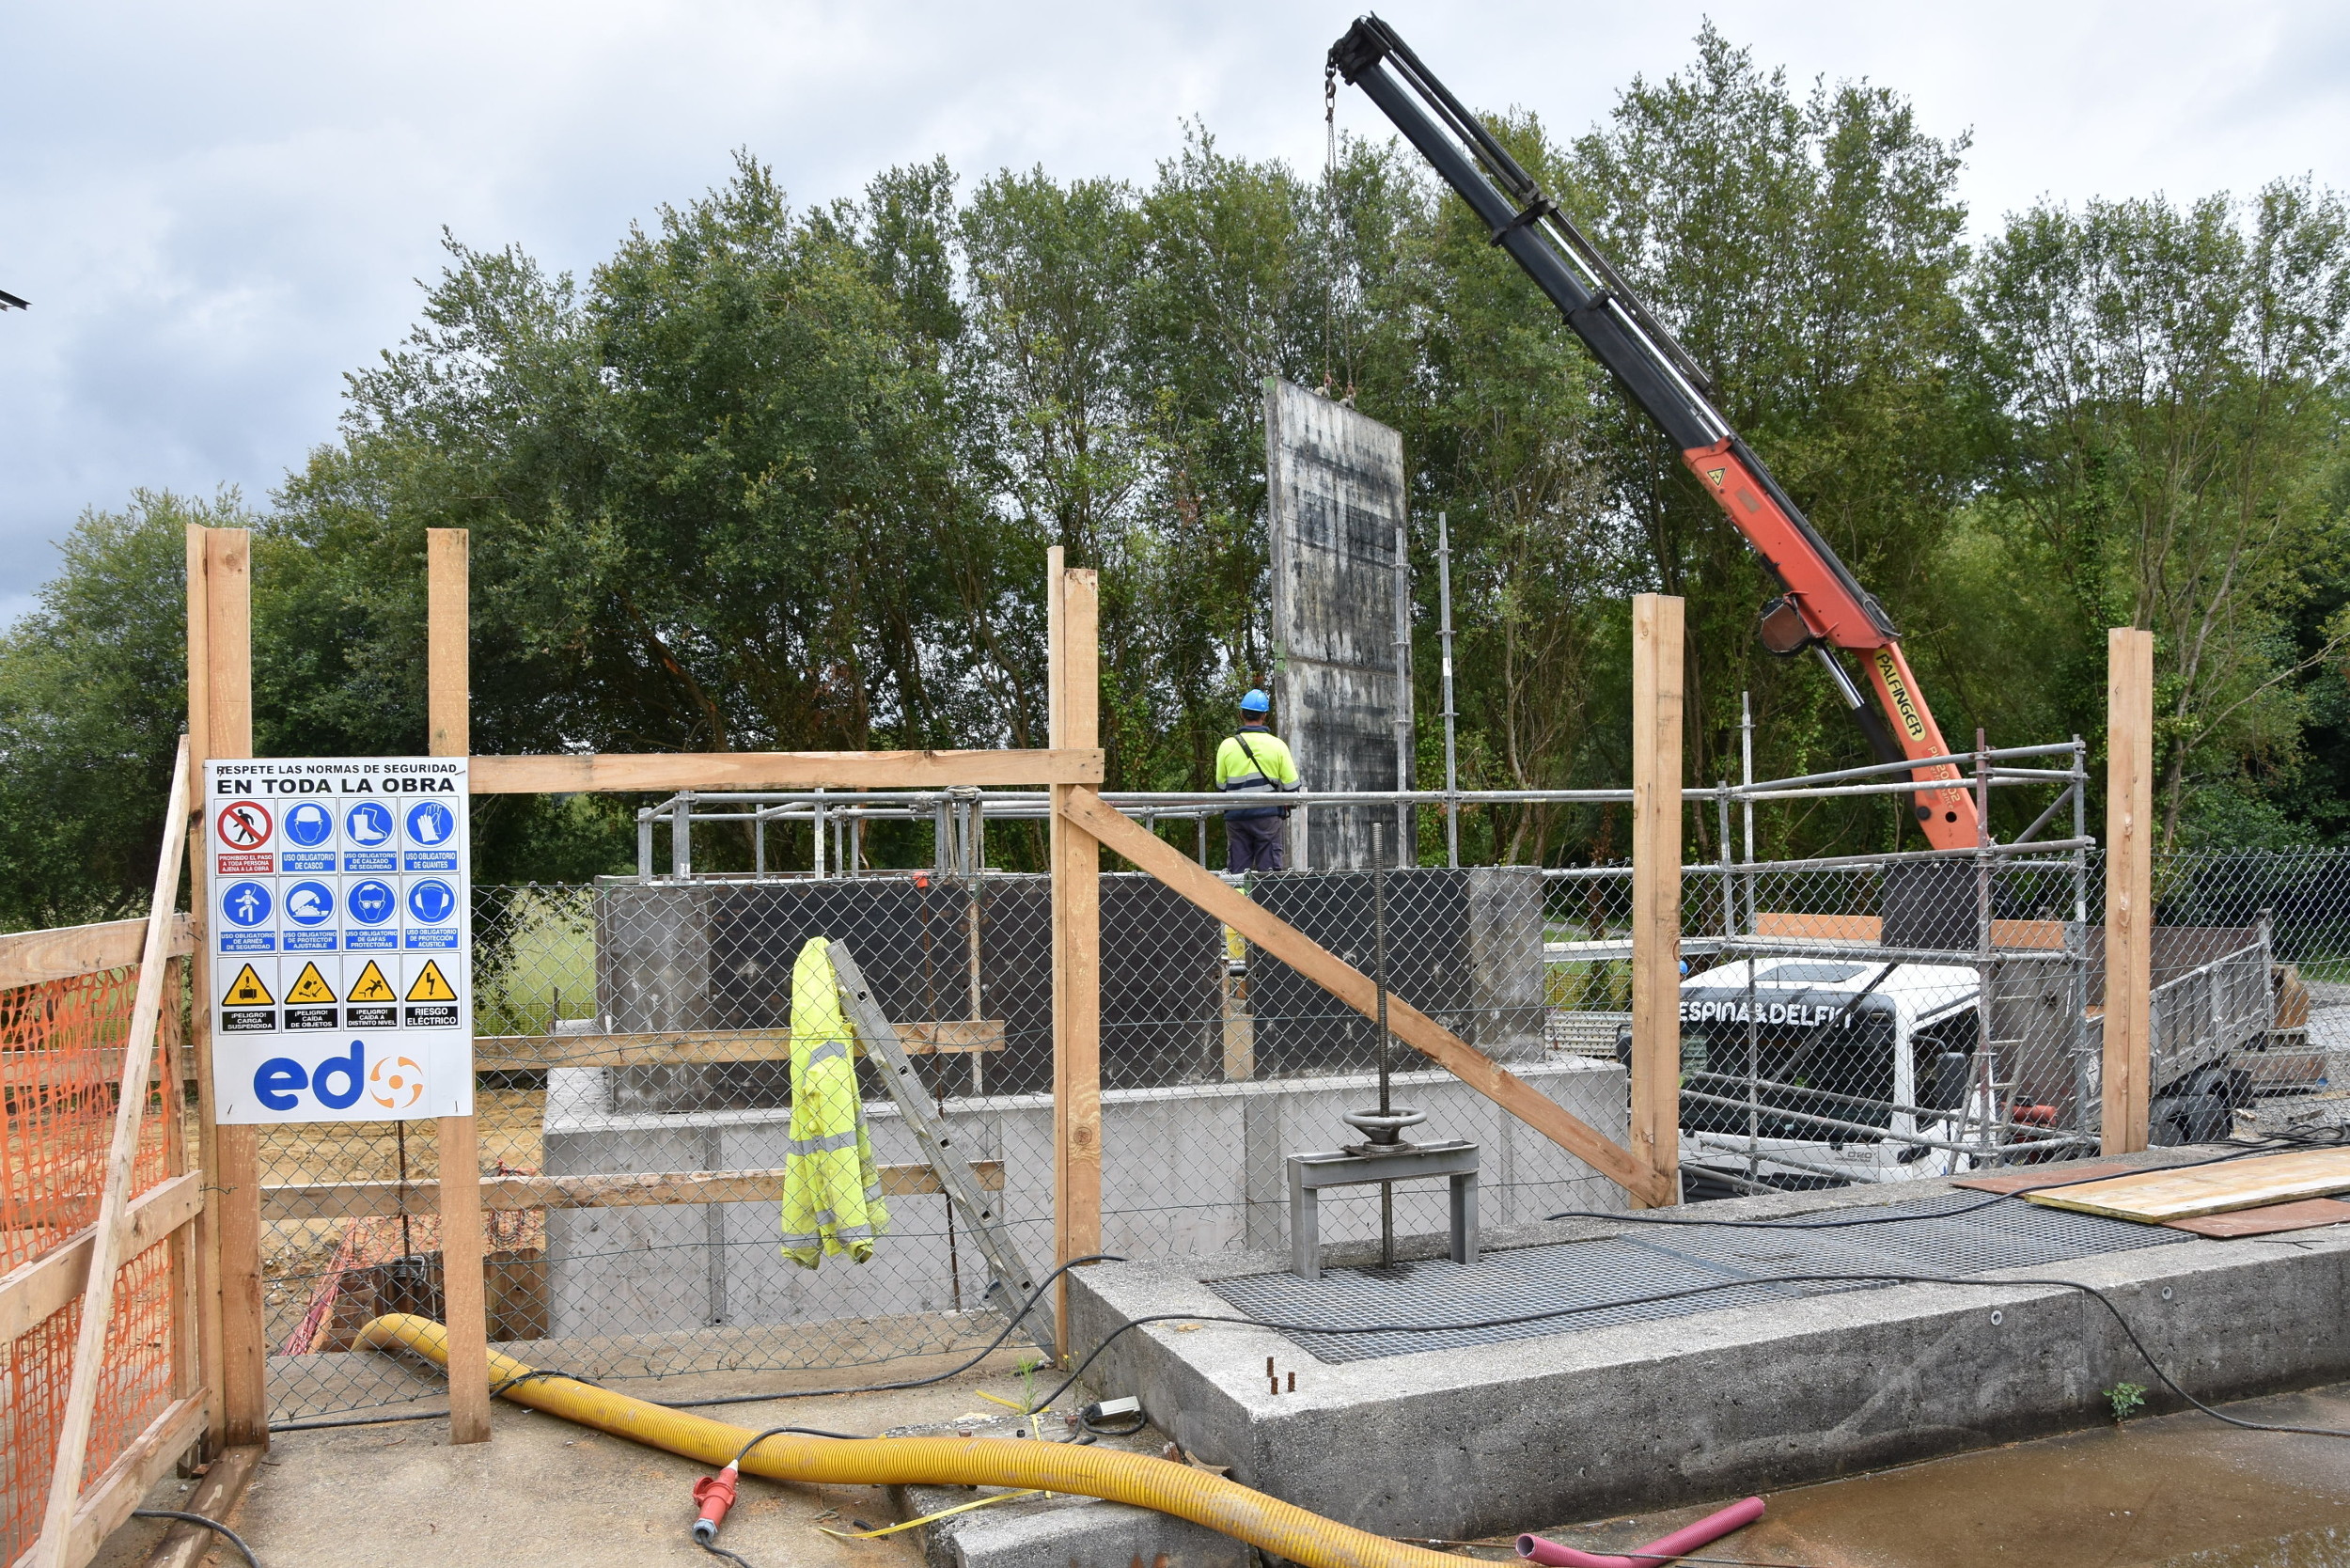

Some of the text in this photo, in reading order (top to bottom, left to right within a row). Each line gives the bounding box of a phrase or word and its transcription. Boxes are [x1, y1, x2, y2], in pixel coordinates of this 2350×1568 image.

[1876, 653, 1922, 736] PALFINGER
[216, 764, 457, 775] RESPETE LAS NORMAS DE SEGURIDAD
[216, 777, 455, 794] EN TODA LA OBRA
[1929, 764, 1954, 809] erfoance
[1936, 763, 1961, 803] 2002
[407, 1015, 456, 1026] ELÉCTRICO
[415, 1008, 448, 1016] RIESGO
